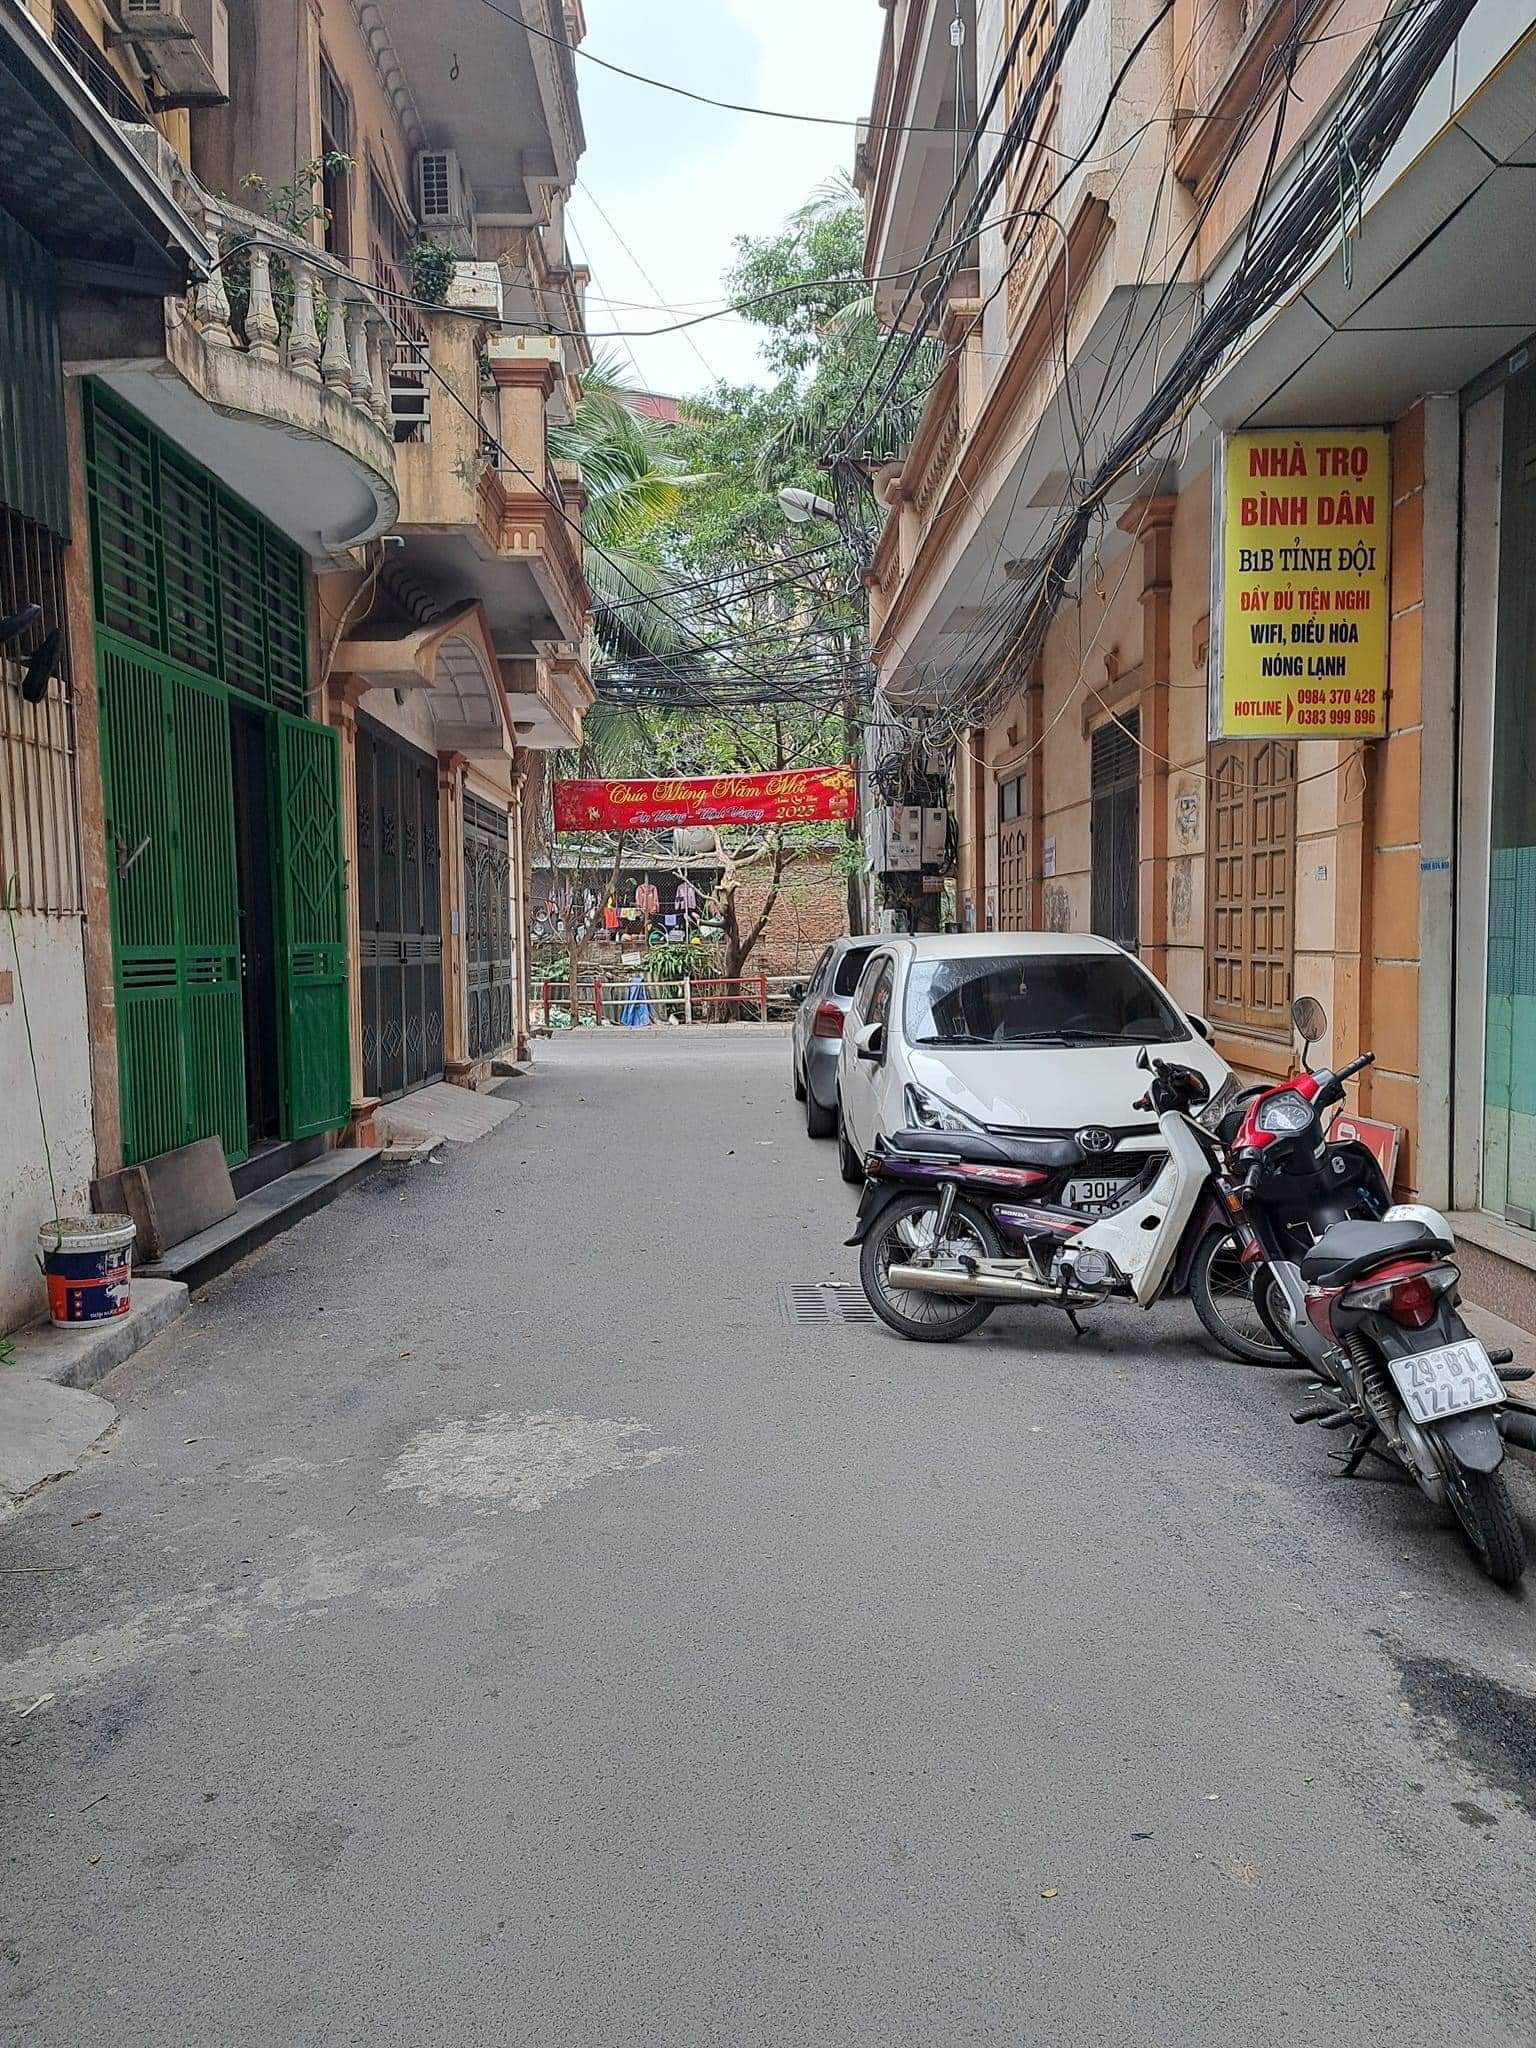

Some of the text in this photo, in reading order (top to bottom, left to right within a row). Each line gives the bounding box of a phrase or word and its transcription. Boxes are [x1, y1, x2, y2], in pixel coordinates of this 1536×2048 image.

[1249, 441, 1368, 482] NHÀ TRỌ
[1241, 490, 1375, 526] BÌNH DÂN
[1280, 537, 1332, 571] TỈNH
[1338, 539, 1376, 577] ĐỘI
[1241, 582, 1370, 614] ĐẦY ĐỦ TIỆN NGHI
[1251, 617, 1358, 646] WIFI, ĐIỀU HÒA
[1262, 652, 1346, 680] NÓNG LẠNH
[1234, 701, 1282, 716] HOTLINE
[1297, 689, 1375, 704] 0984 370 428
[1297, 709, 1375, 724] 0383 999 896
[606, 782, 648, 804] Chúc
[652, 781, 706, 809] Mừng
[712, 778, 761, 798] Năm
[776, 805, 816, 820] 2025
[1083, 1182, 1117, 1199] 30H
[1001, 1209, 1029, 1219] HONDA
[1411, 1373, 1497, 1417] 122.23
